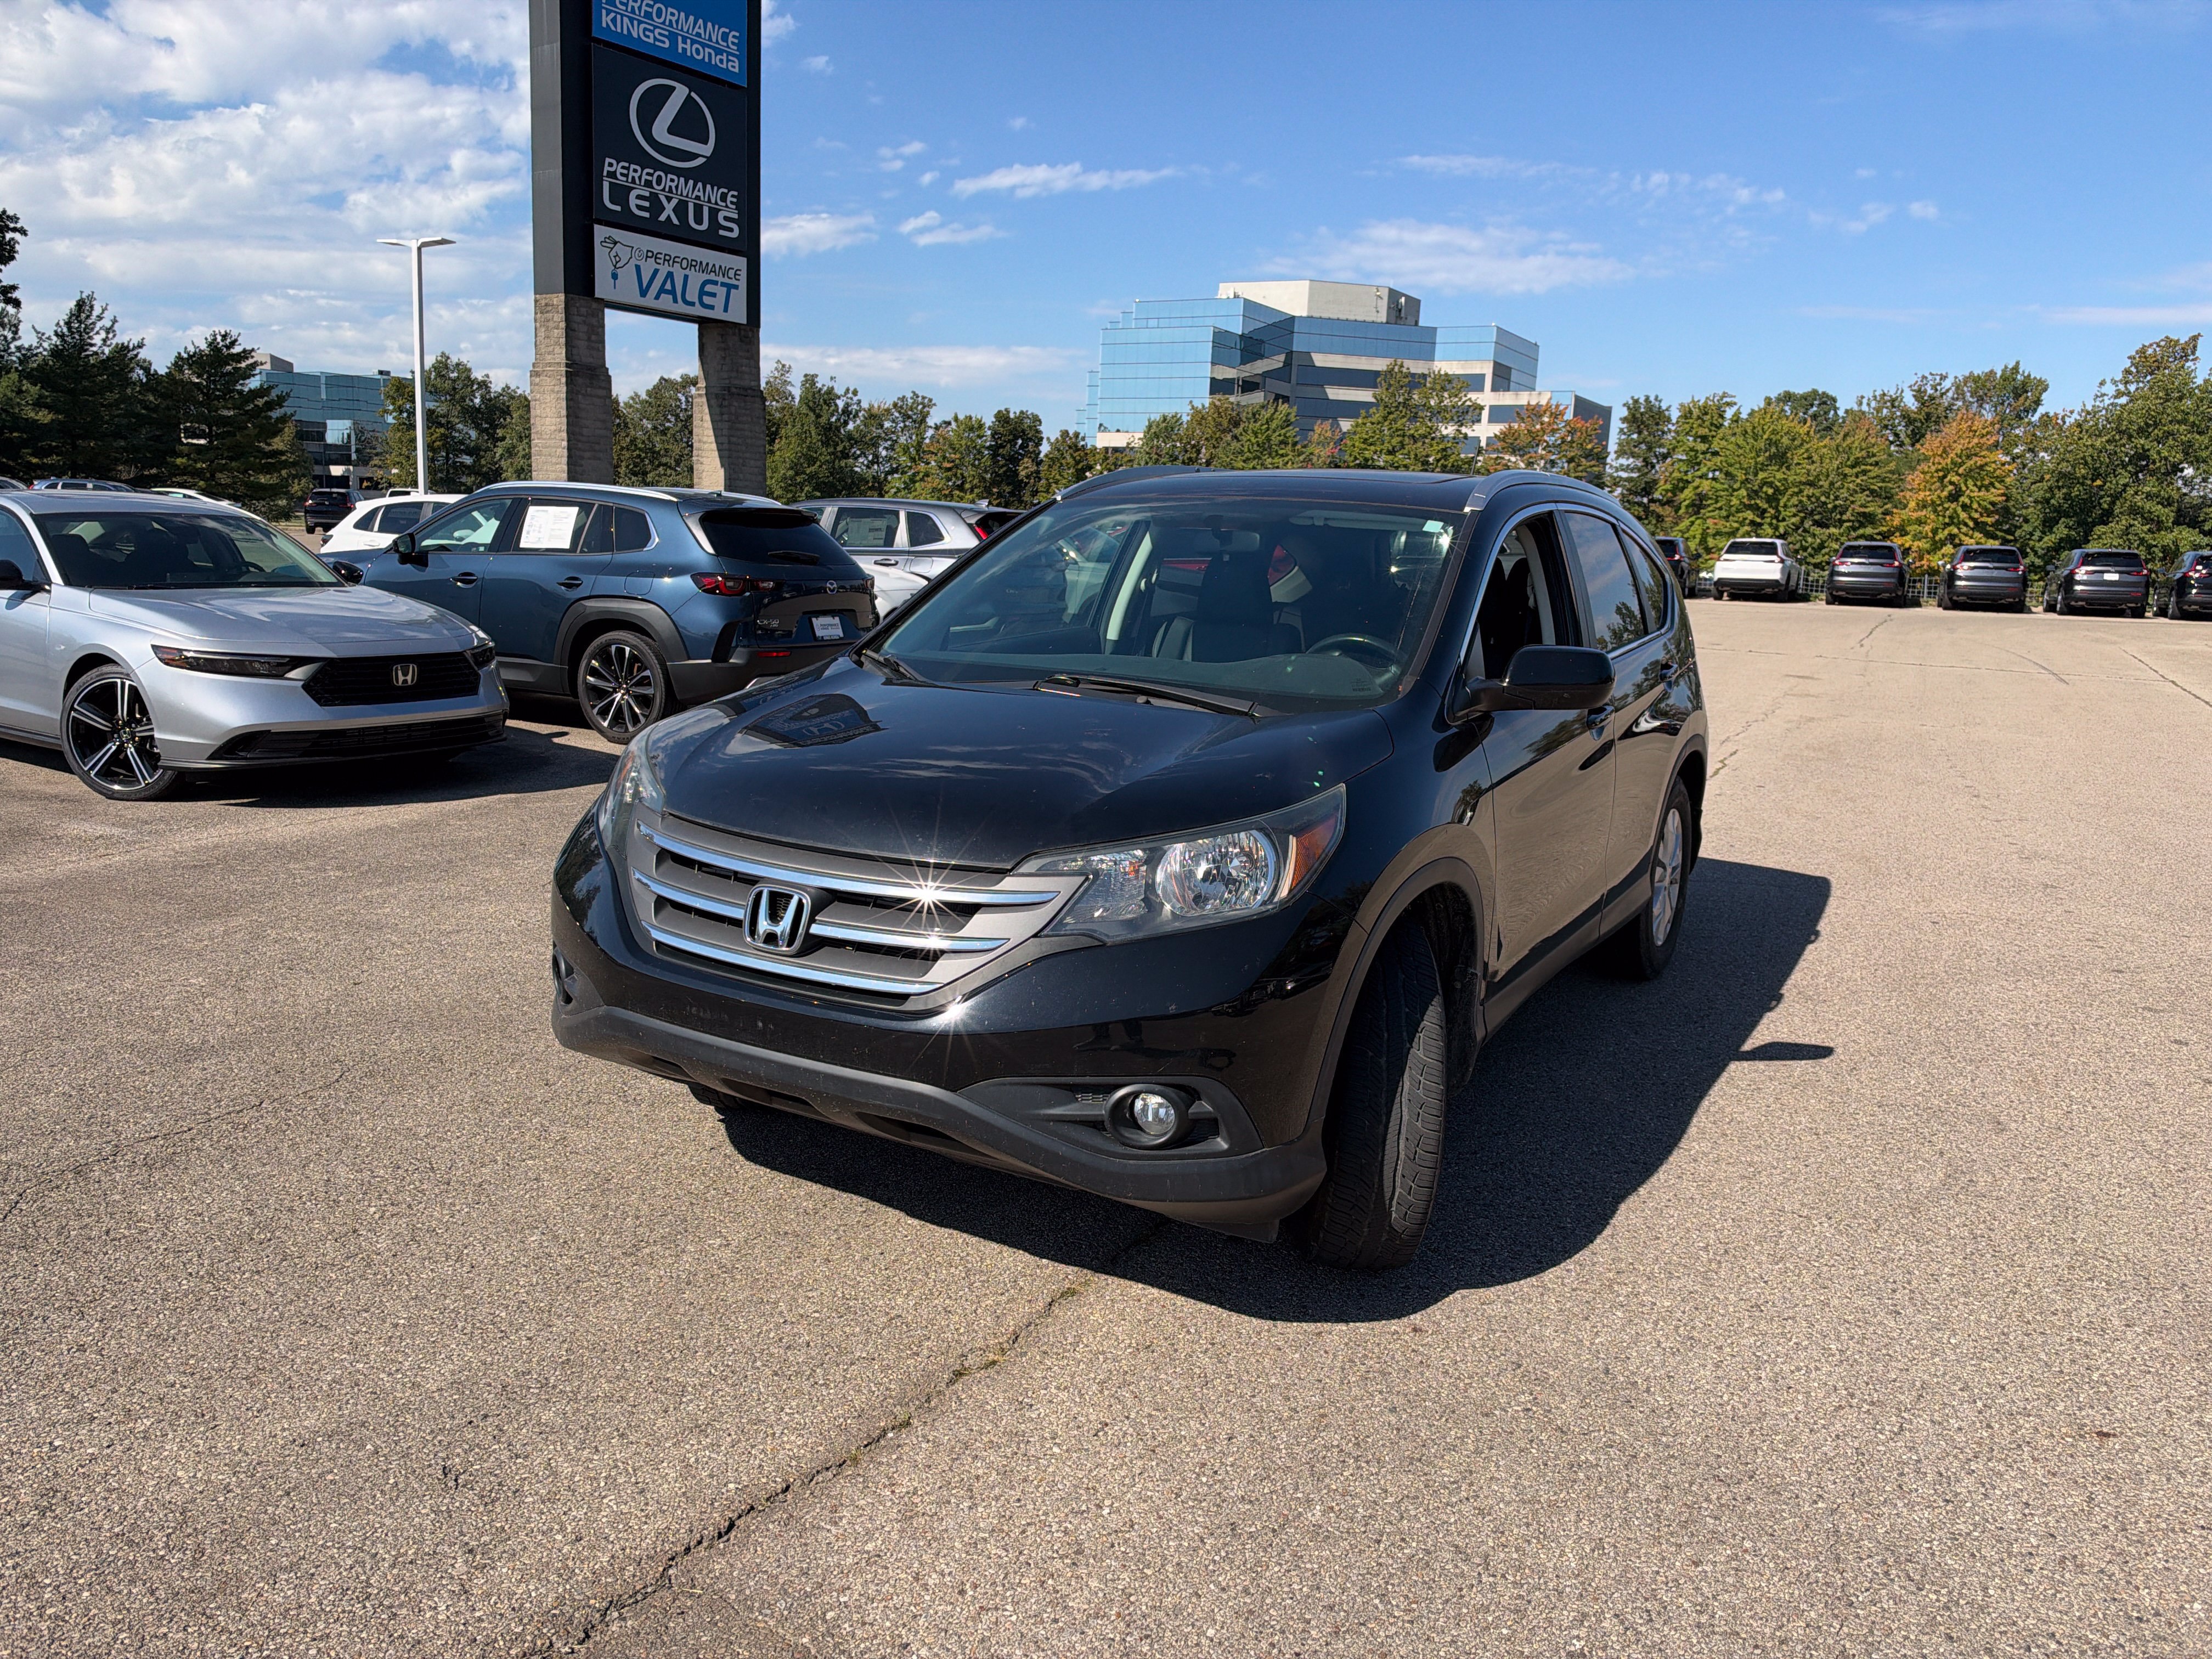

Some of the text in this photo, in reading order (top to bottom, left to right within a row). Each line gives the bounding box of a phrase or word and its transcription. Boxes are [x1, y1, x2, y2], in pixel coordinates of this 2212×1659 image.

[601, 9, 740, 73] KINGS Honda
[602, 0, 740, 50] ERFORMANCE
[603, 157, 738, 209] PERFORMANCE
[602, 180, 740, 238] LEXUS
[634, 264, 740, 313] VALET
[645, 249, 742, 281] PERFORMANCE
